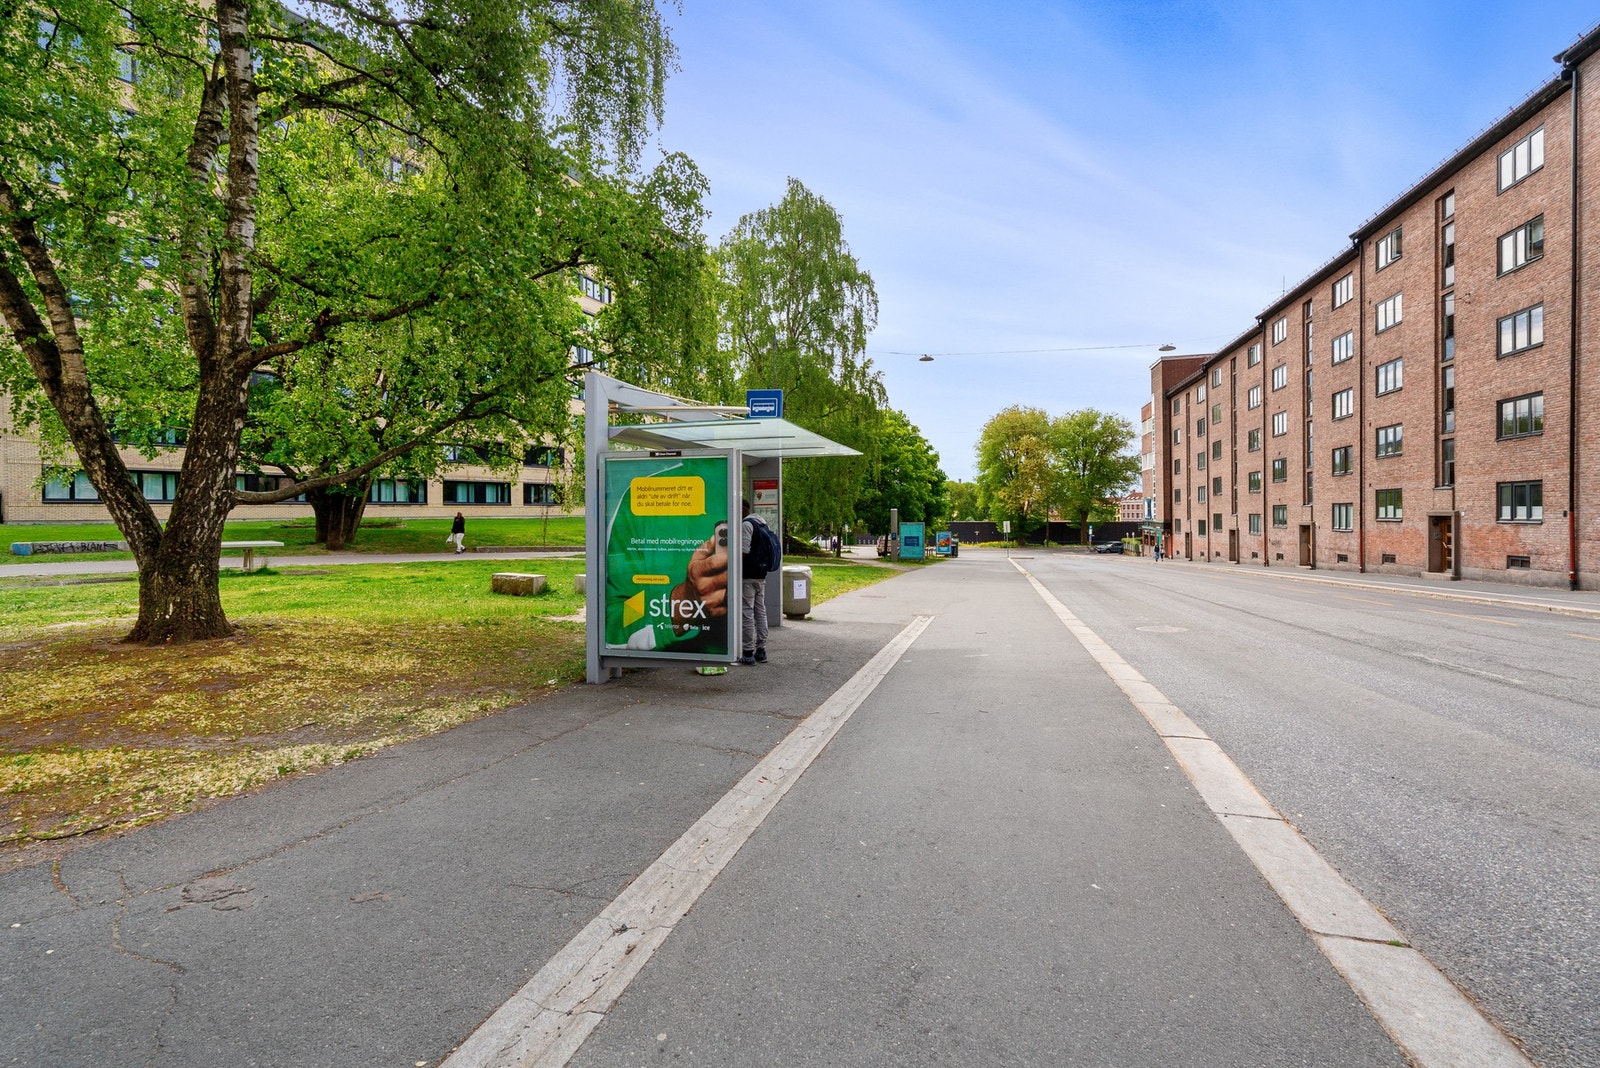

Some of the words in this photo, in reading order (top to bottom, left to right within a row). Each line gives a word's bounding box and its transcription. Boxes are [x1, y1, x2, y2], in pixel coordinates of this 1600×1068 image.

[630, 537, 646, 545] Betal
[646, 537, 660, 545] med
[660, 537, 705, 547] mobilregningen
[649, 593, 707, 619] strex
